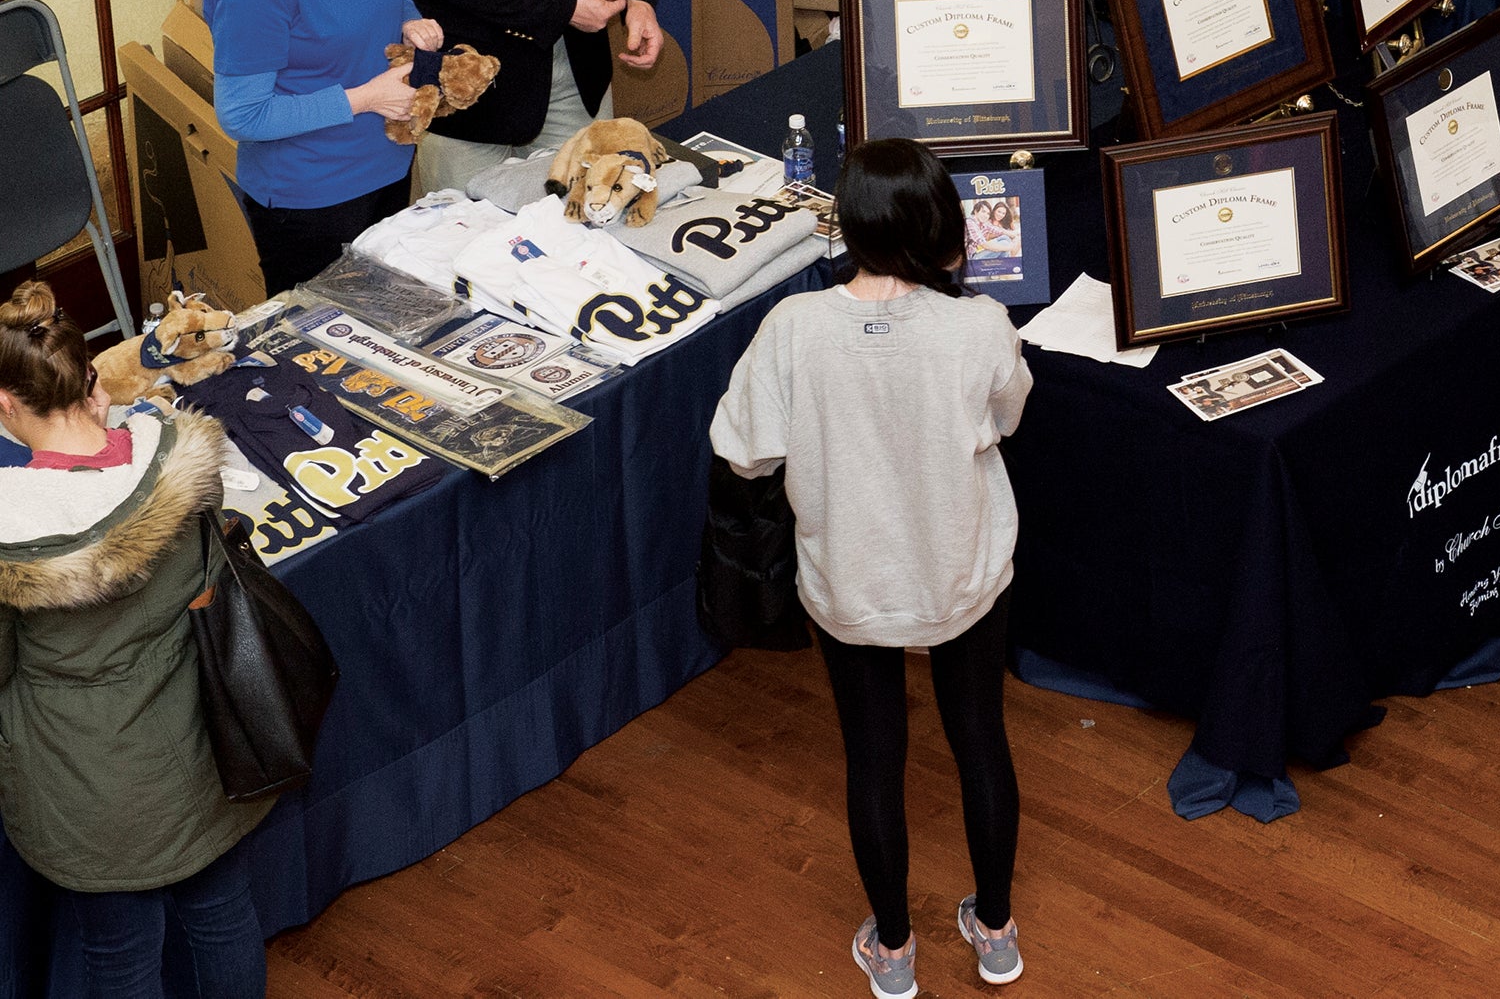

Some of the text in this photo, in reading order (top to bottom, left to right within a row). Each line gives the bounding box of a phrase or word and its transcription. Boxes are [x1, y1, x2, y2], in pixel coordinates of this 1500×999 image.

[906, 12, 1015, 35] CUSTOM DIPLOMA FRAME
[926, 113, 1011, 126] University of Pittsburgh
[1419, 101, 1485, 146] CUSTOM DIPLOMA FRAME
[970, 175, 1006, 195] Pitt
[1172, 194, 1278, 225] CUSTOM DIPLOMA FRAME
[671, 198, 801, 260] Pitt
[570, 273, 711, 342] Pitt
[348, 334, 402, 365] Pittsburgh
[438, 322, 491, 356] VINYL DECAL
[404, 356, 422, 370] of
[423, 364, 479, 396] University
[549, 370, 592, 394] Alumni
[283, 429, 431, 510] Pitt
[1434, 557, 1445, 573] by
[1445, 515, 1490, 563] Church
